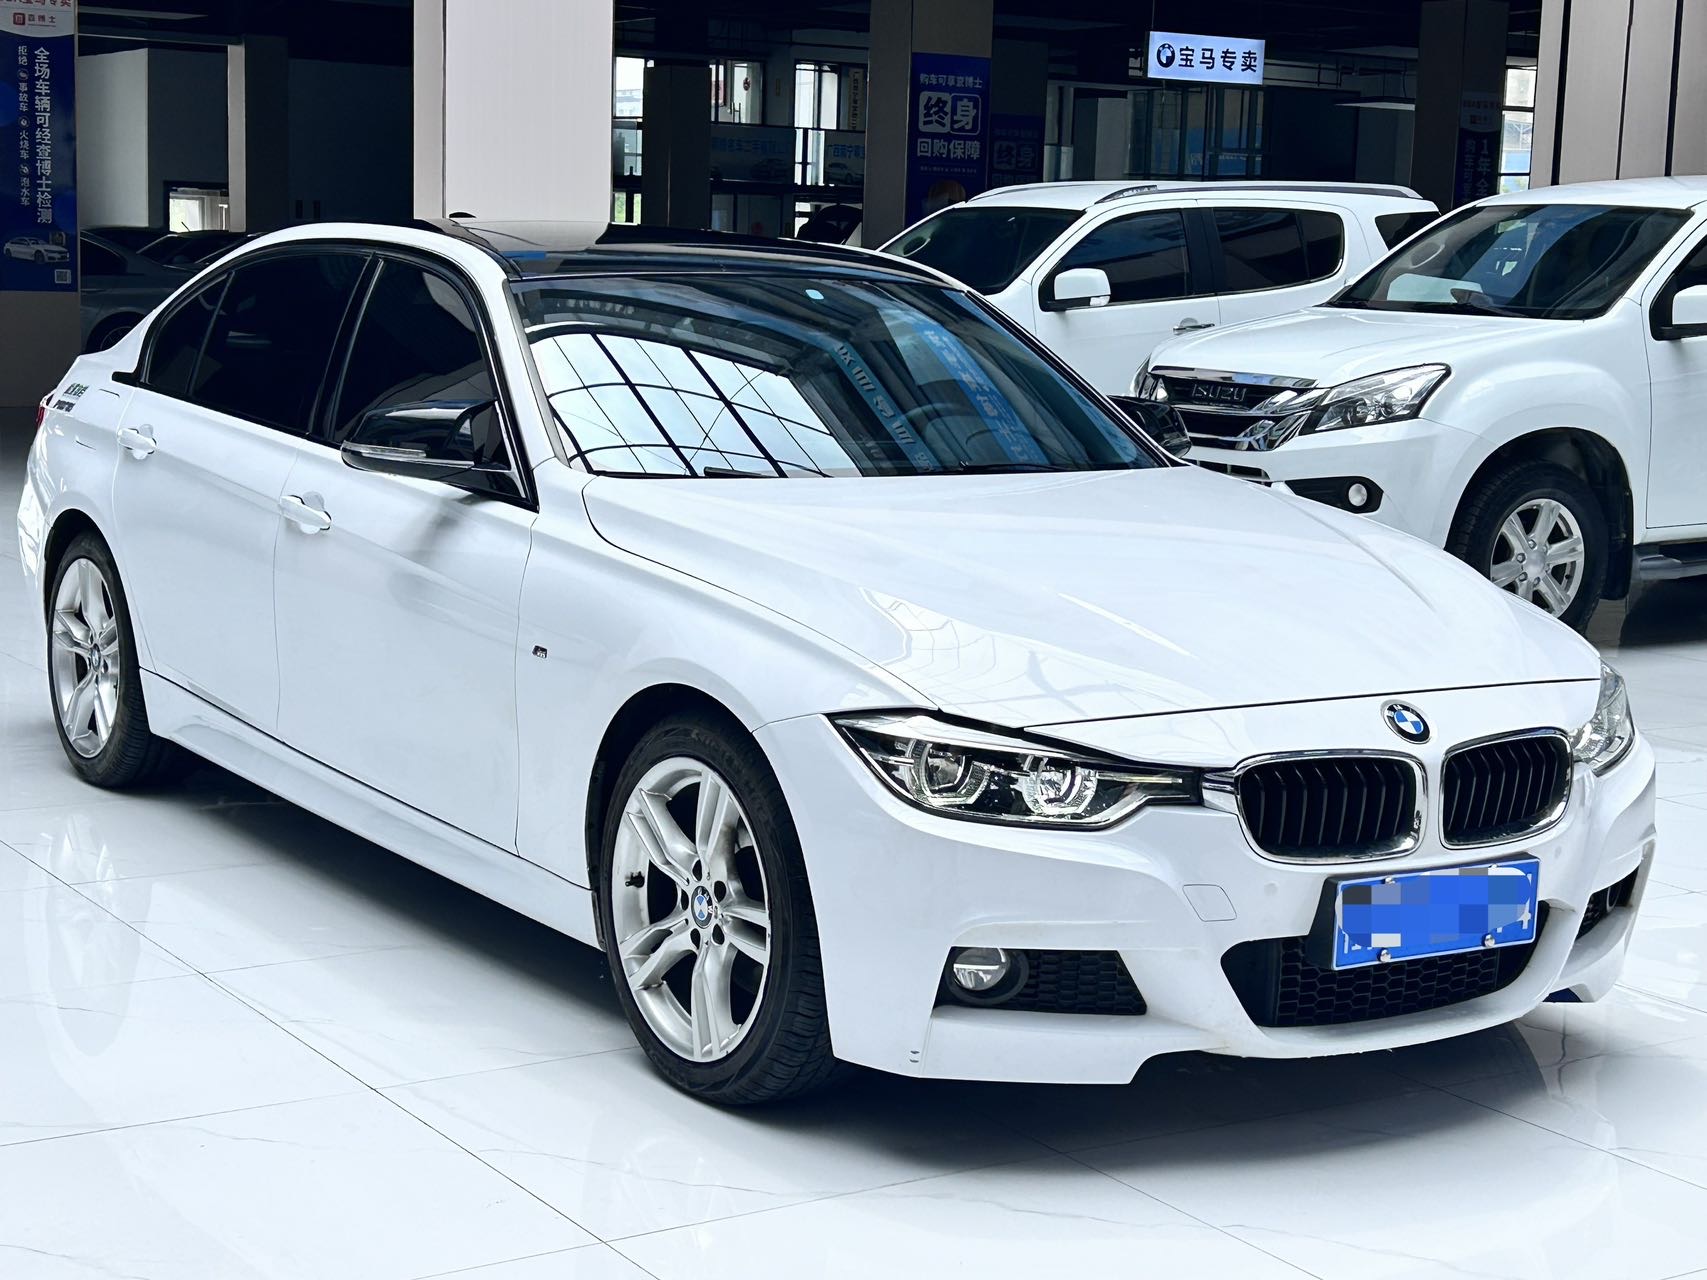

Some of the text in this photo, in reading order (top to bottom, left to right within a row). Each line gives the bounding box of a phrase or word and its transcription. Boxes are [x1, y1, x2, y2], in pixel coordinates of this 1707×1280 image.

[1178, 46, 1257, 72] 宝马专卖
[923, 96, 976, 130] 终身
[34, 46, 53, 224] 全场车辆可经查博士检测
[917, 138, 981, 160] 回购保障
[1192, 383, 1247, 401] ISUZU
